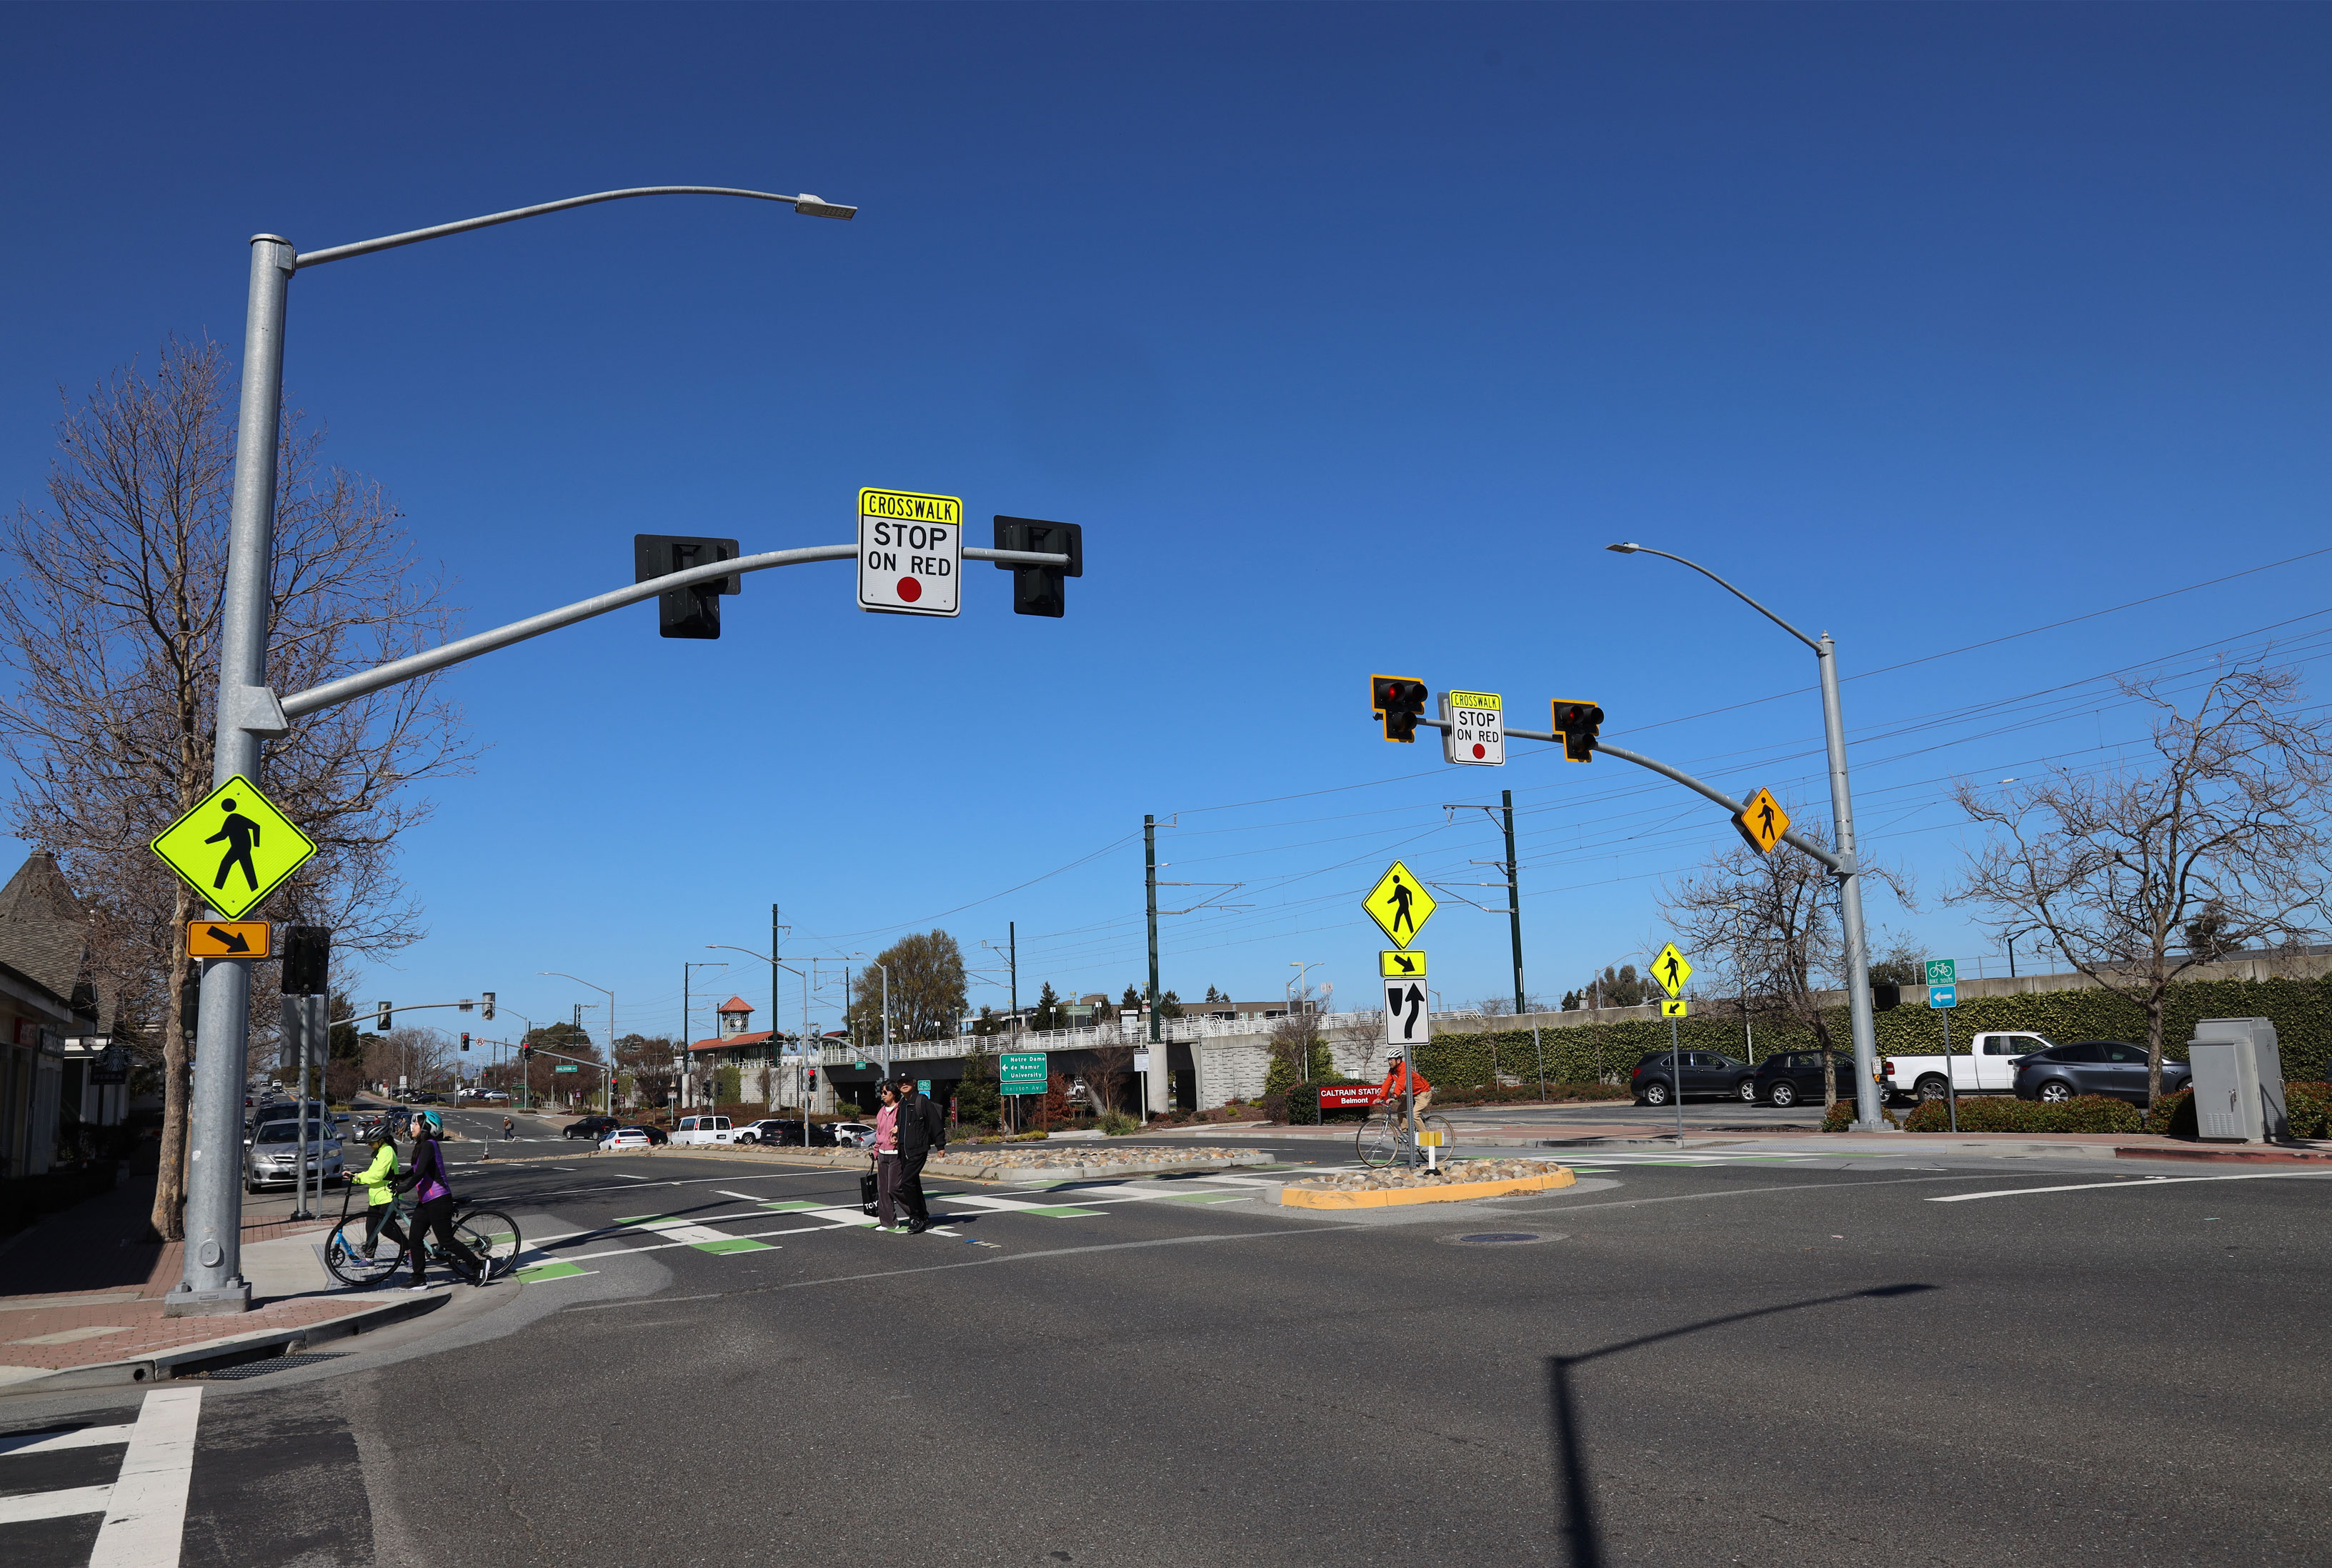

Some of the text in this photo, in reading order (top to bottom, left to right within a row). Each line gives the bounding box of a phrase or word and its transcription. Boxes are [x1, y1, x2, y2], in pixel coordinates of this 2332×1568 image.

[869, 495, 952, 521] CROSSWALK
[874, 521, 947, 551] STOP
[868, 551, 951, 576] ON RED
[1455, 694, 1498, 709] CROSSWALK
[1459, 711, 1495, 727] STOP
[1457, 729, 1499, 743] ON RED
[864, 1199, 879, 1210] TOY
